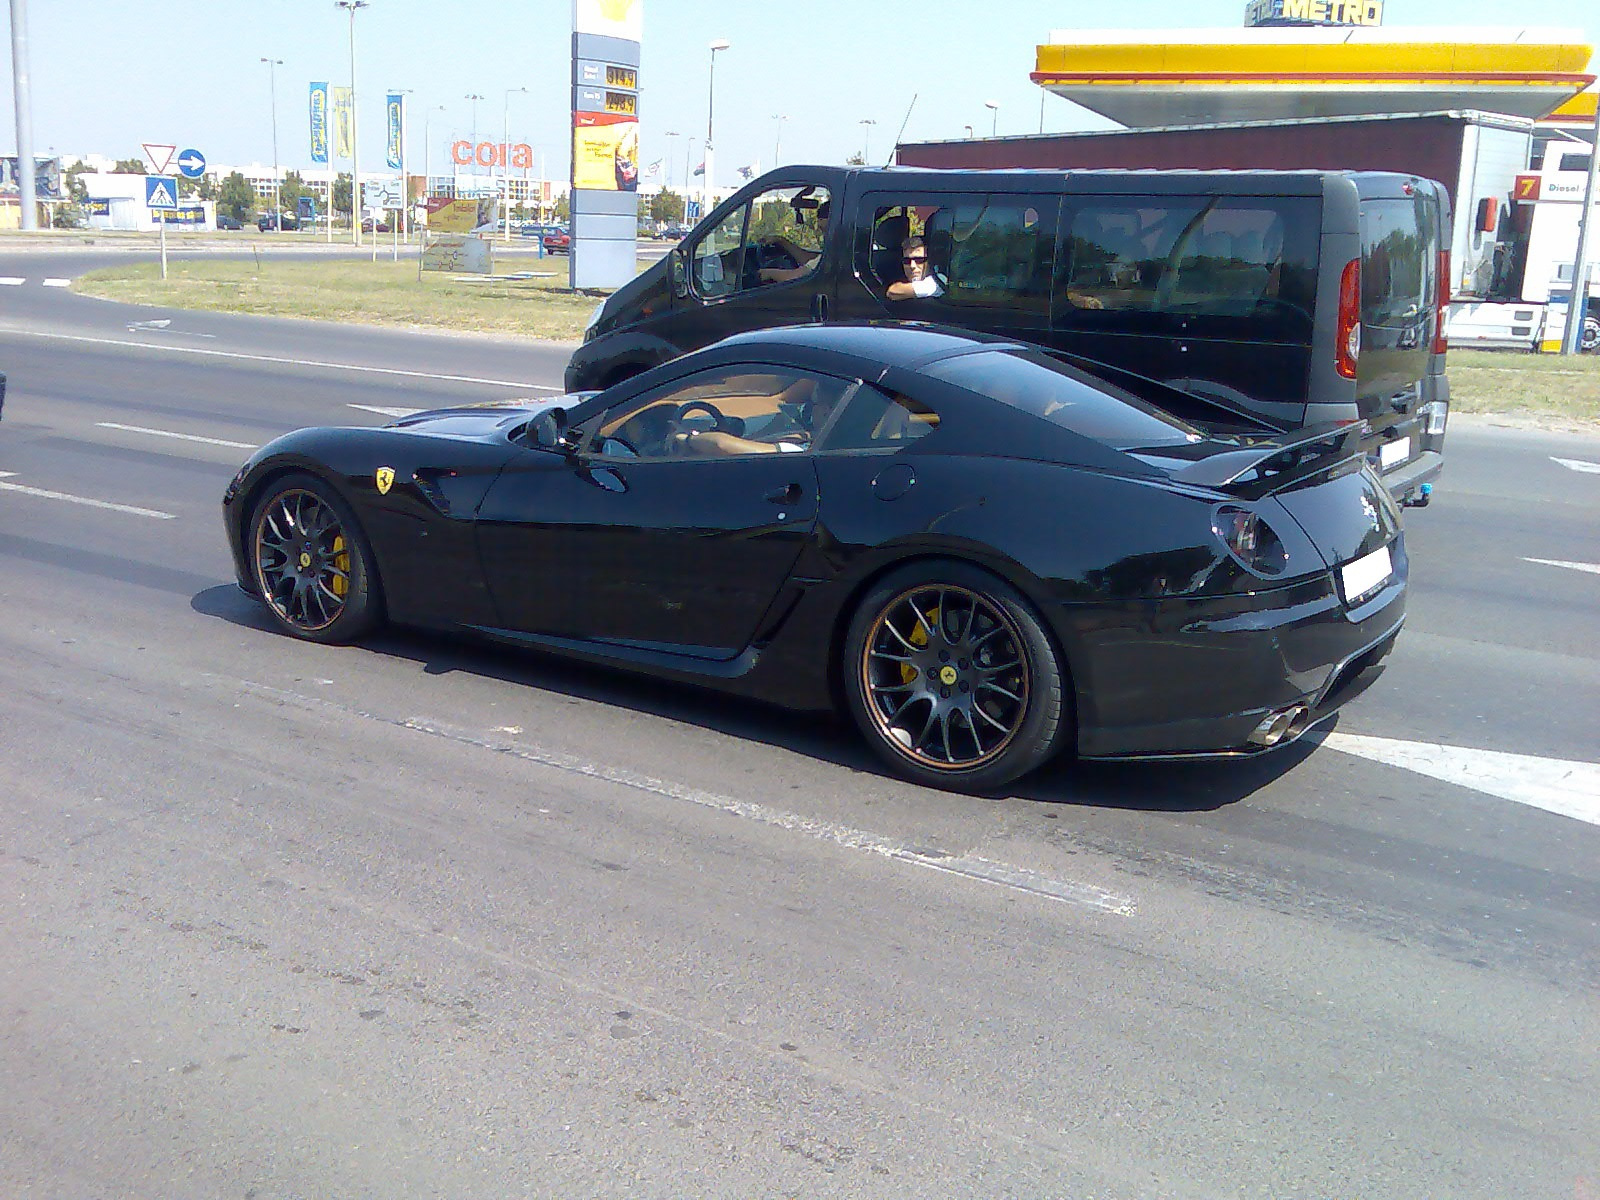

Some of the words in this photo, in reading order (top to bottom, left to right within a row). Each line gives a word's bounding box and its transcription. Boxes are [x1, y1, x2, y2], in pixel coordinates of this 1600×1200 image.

[1282, 0, 1381, 25] METRO
[452, 140, 533, 168] cora
[1520, 179, 1536, 196] 7
[1548, 183, 1580, 193] Diesel
